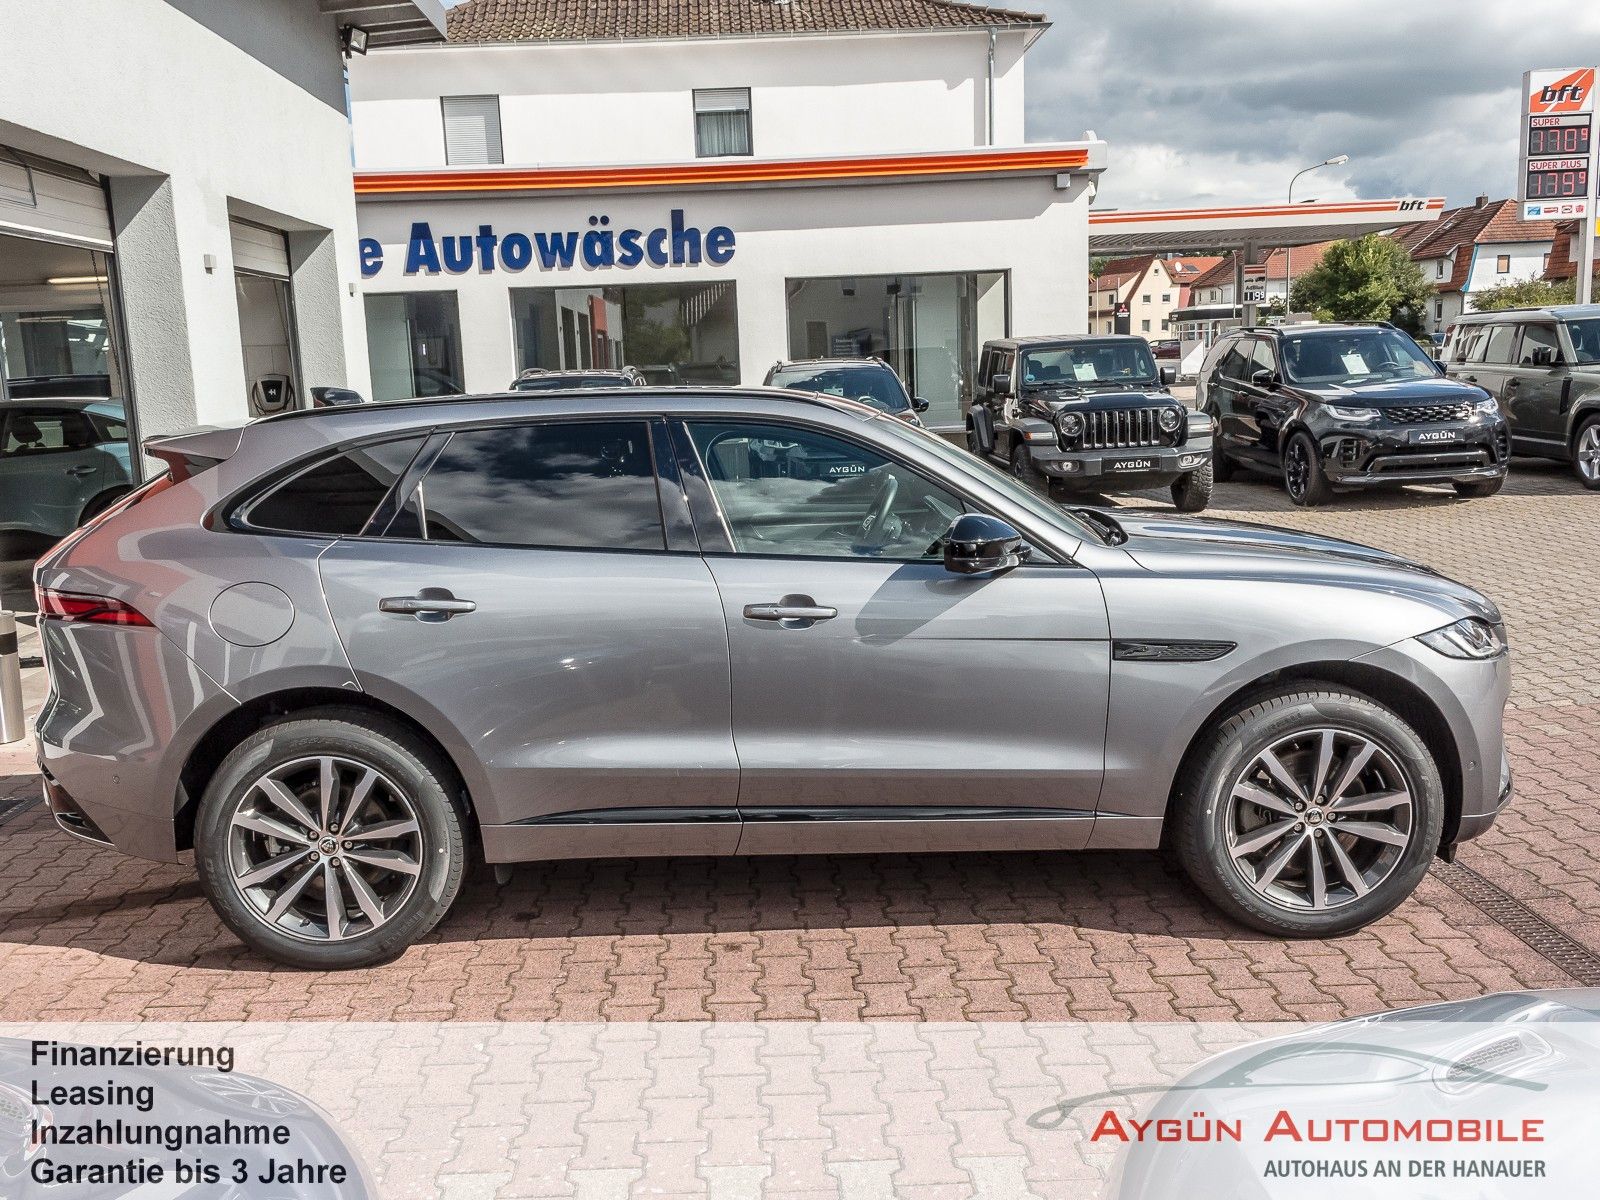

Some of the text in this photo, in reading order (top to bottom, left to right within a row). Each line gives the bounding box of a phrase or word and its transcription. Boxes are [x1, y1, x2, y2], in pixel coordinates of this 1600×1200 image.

[1540, 85, 1584, 104] bft
[1532, 118, 1560, 127] SUPER
[1530, 160, 1582, 170] SUPER PLUS
[1399, 200, 1425, 211] bft
[405, 209, 736, 274] Autowäsche
[1419, 430, 1456, 440] AYGÜN
[829, 464, 865, 473] AYGÜN
[1113, 459, 1151, 469] AYGÜN
